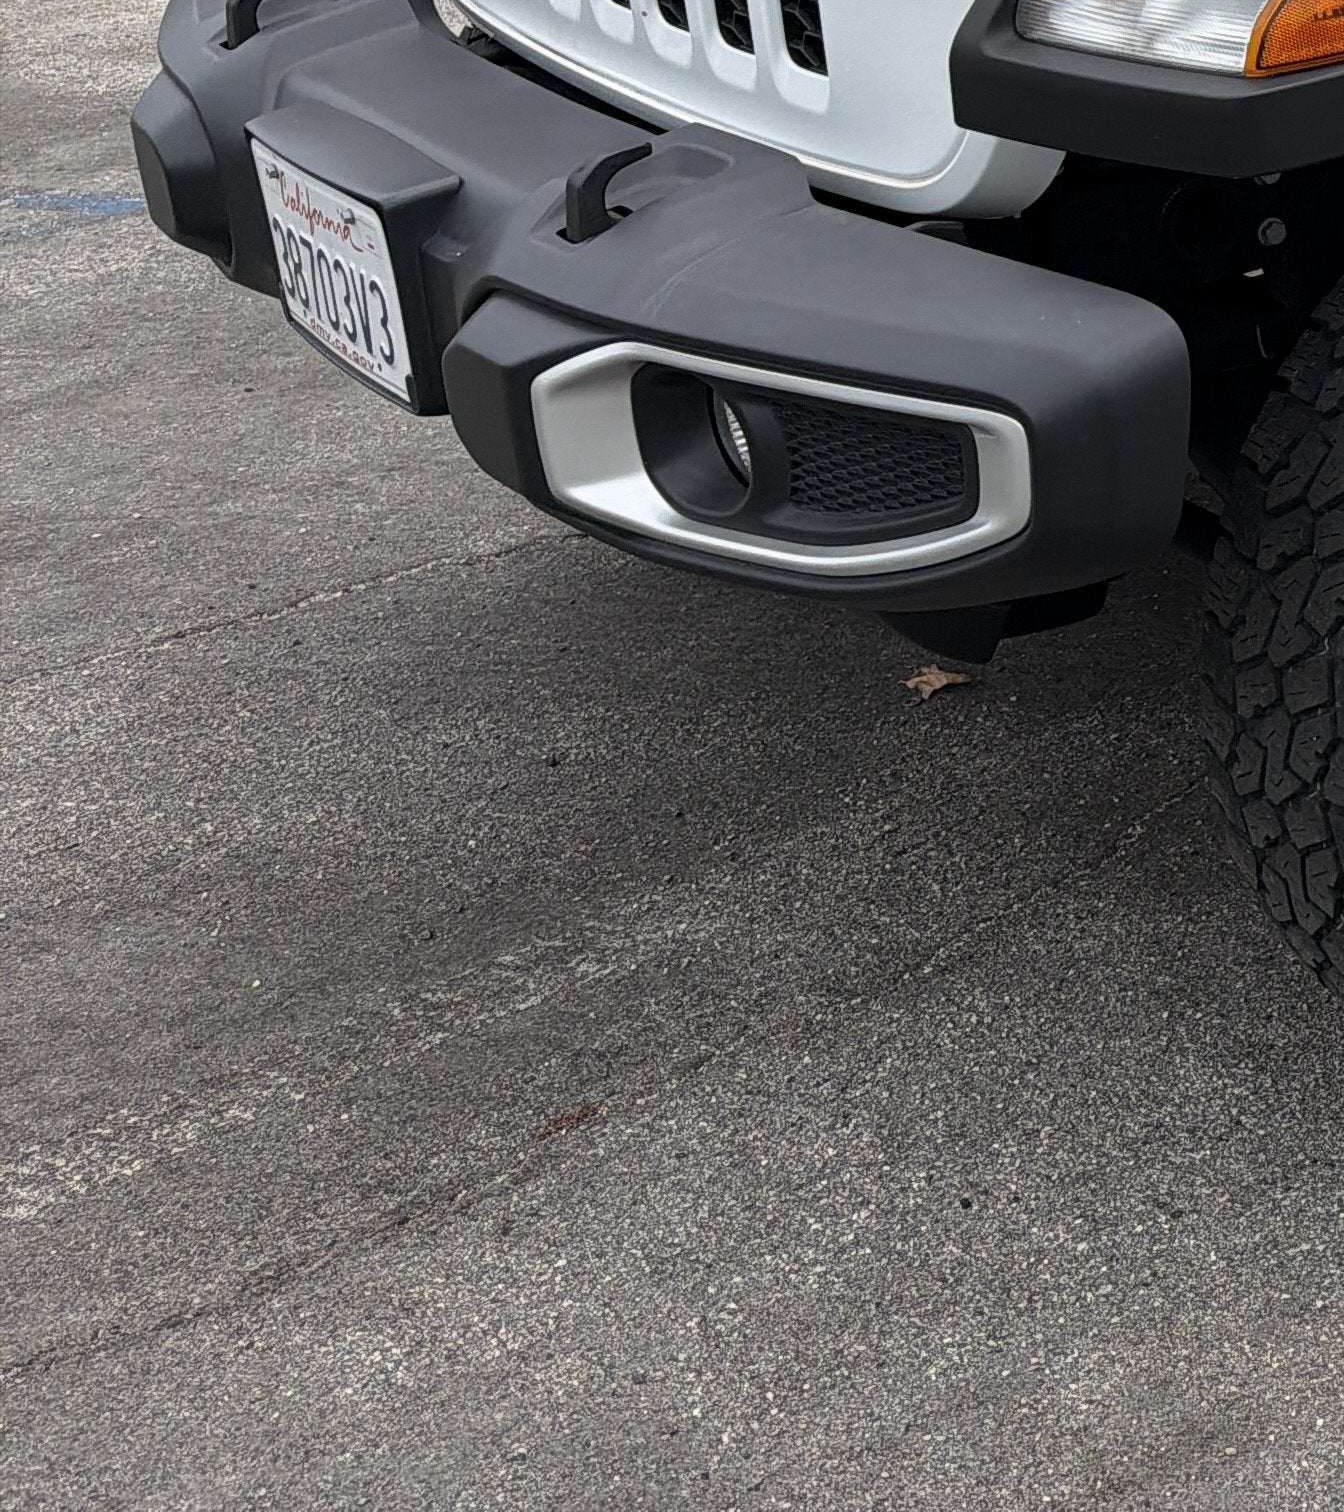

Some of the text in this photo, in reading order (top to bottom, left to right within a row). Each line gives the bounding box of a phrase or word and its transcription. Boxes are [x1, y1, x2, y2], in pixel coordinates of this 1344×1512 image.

[278, 171, 365, 252] California
[272, 215, 395, 367] 38703V3
[309, 317, 376, 372] dmv.ca.gov
